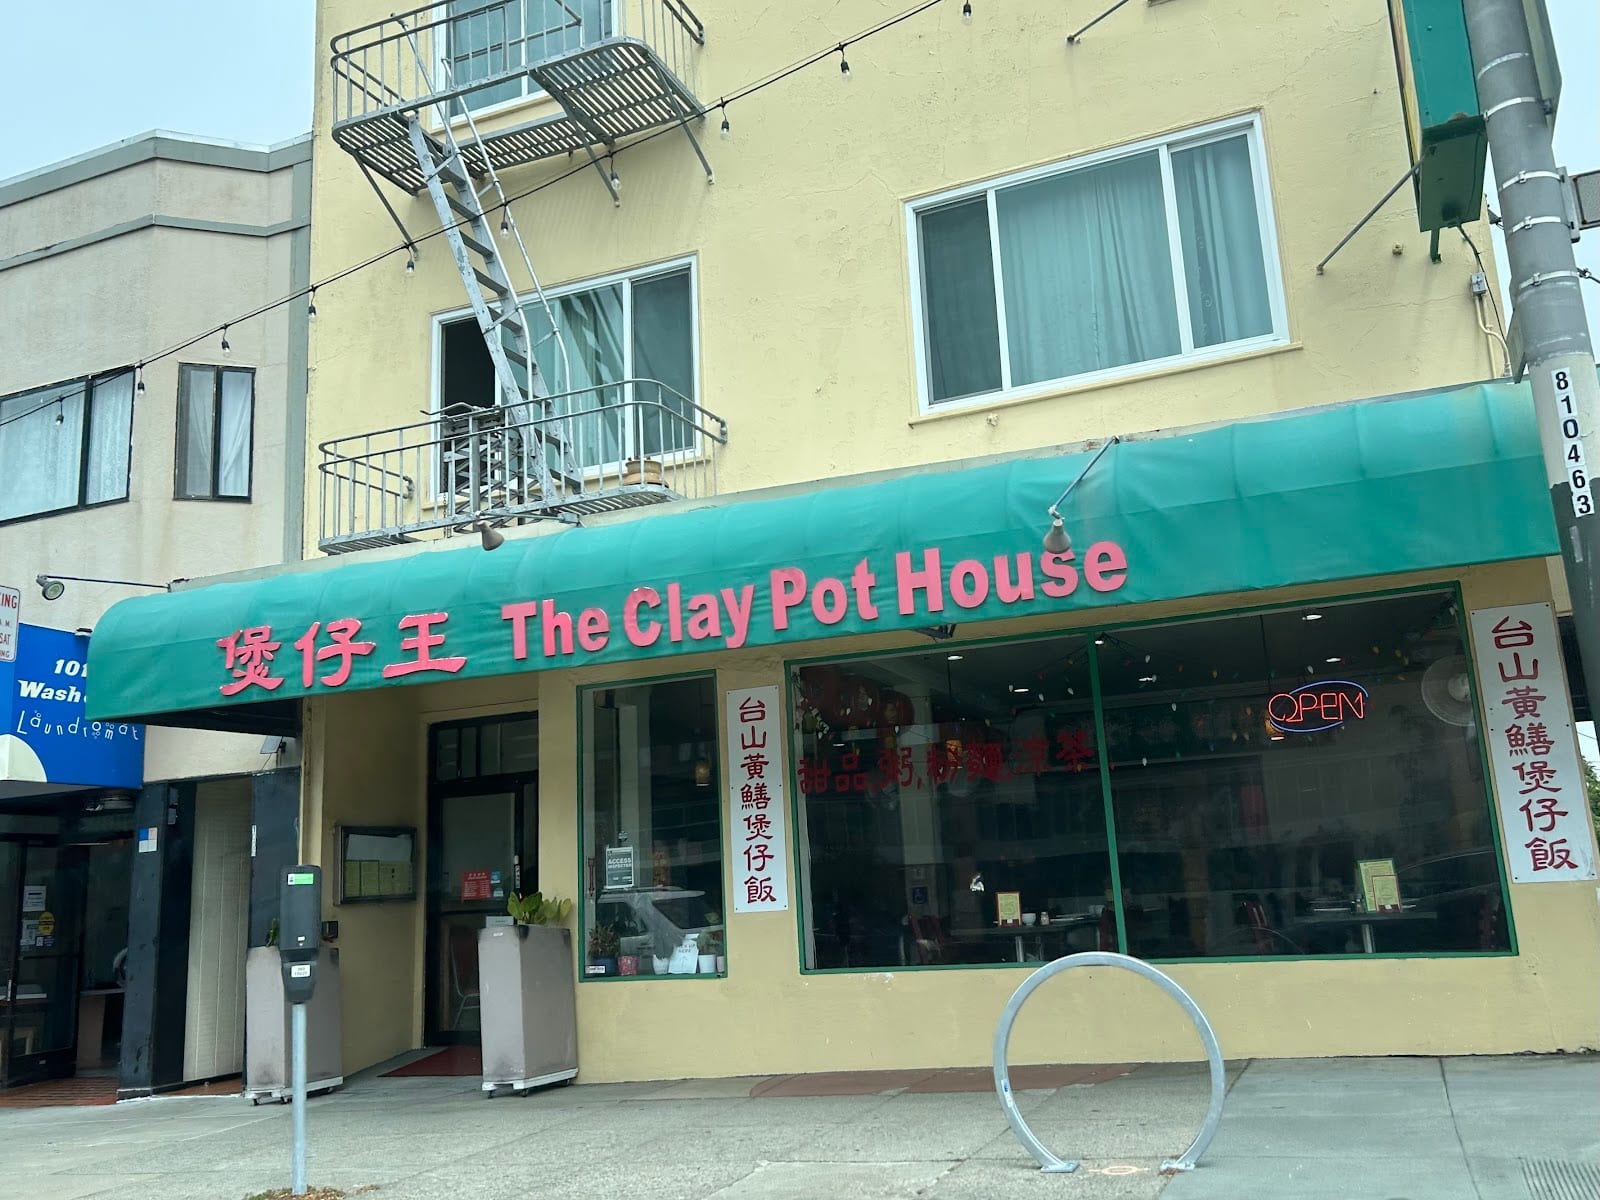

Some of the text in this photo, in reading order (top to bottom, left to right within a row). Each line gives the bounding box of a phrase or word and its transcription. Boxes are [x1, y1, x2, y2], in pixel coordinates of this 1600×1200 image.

[1555, 371, 1591, 514] 810463
[0, 592, 18, 609] ING
[215, 611, 468, 697] 煲仔王
[500, 540, 1129, 660] The Clay Pot House
[1268, 692, 1365, 723] OPEN
[1490, 615, 1580, 872] 台山黃鱔煲仔飯
[738, 695, 777, 904] 台山黃鱔煲仔飯
